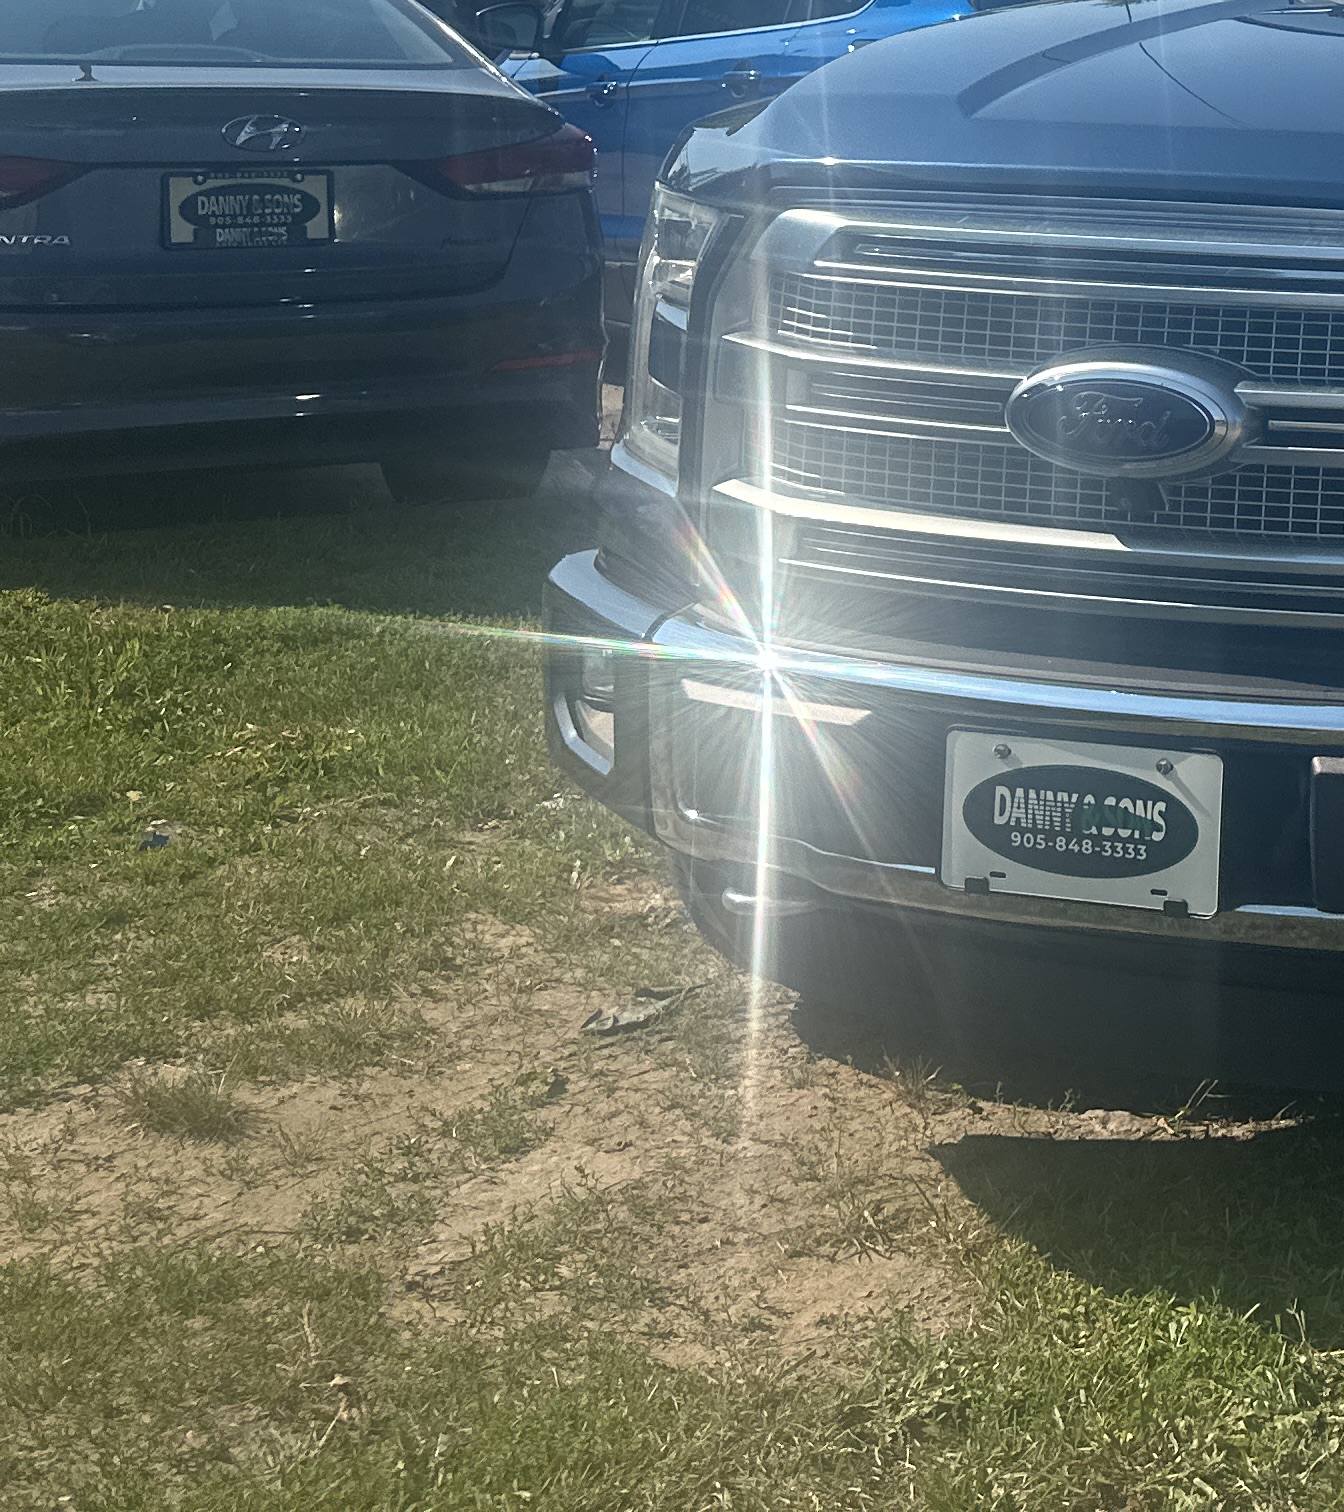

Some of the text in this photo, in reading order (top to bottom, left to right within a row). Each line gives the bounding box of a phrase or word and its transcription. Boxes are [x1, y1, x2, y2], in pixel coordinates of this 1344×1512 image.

[197, 195, 249, 216] DANNY
[264, 193, 304, 214] SONS
[1057, 390, 1172, 450] Ford
[993, 785, 1079, 832] DANNY
[1101, 796, 1167, 842] SONS
[1011, 831, 1148, 861] 905-848-3333
